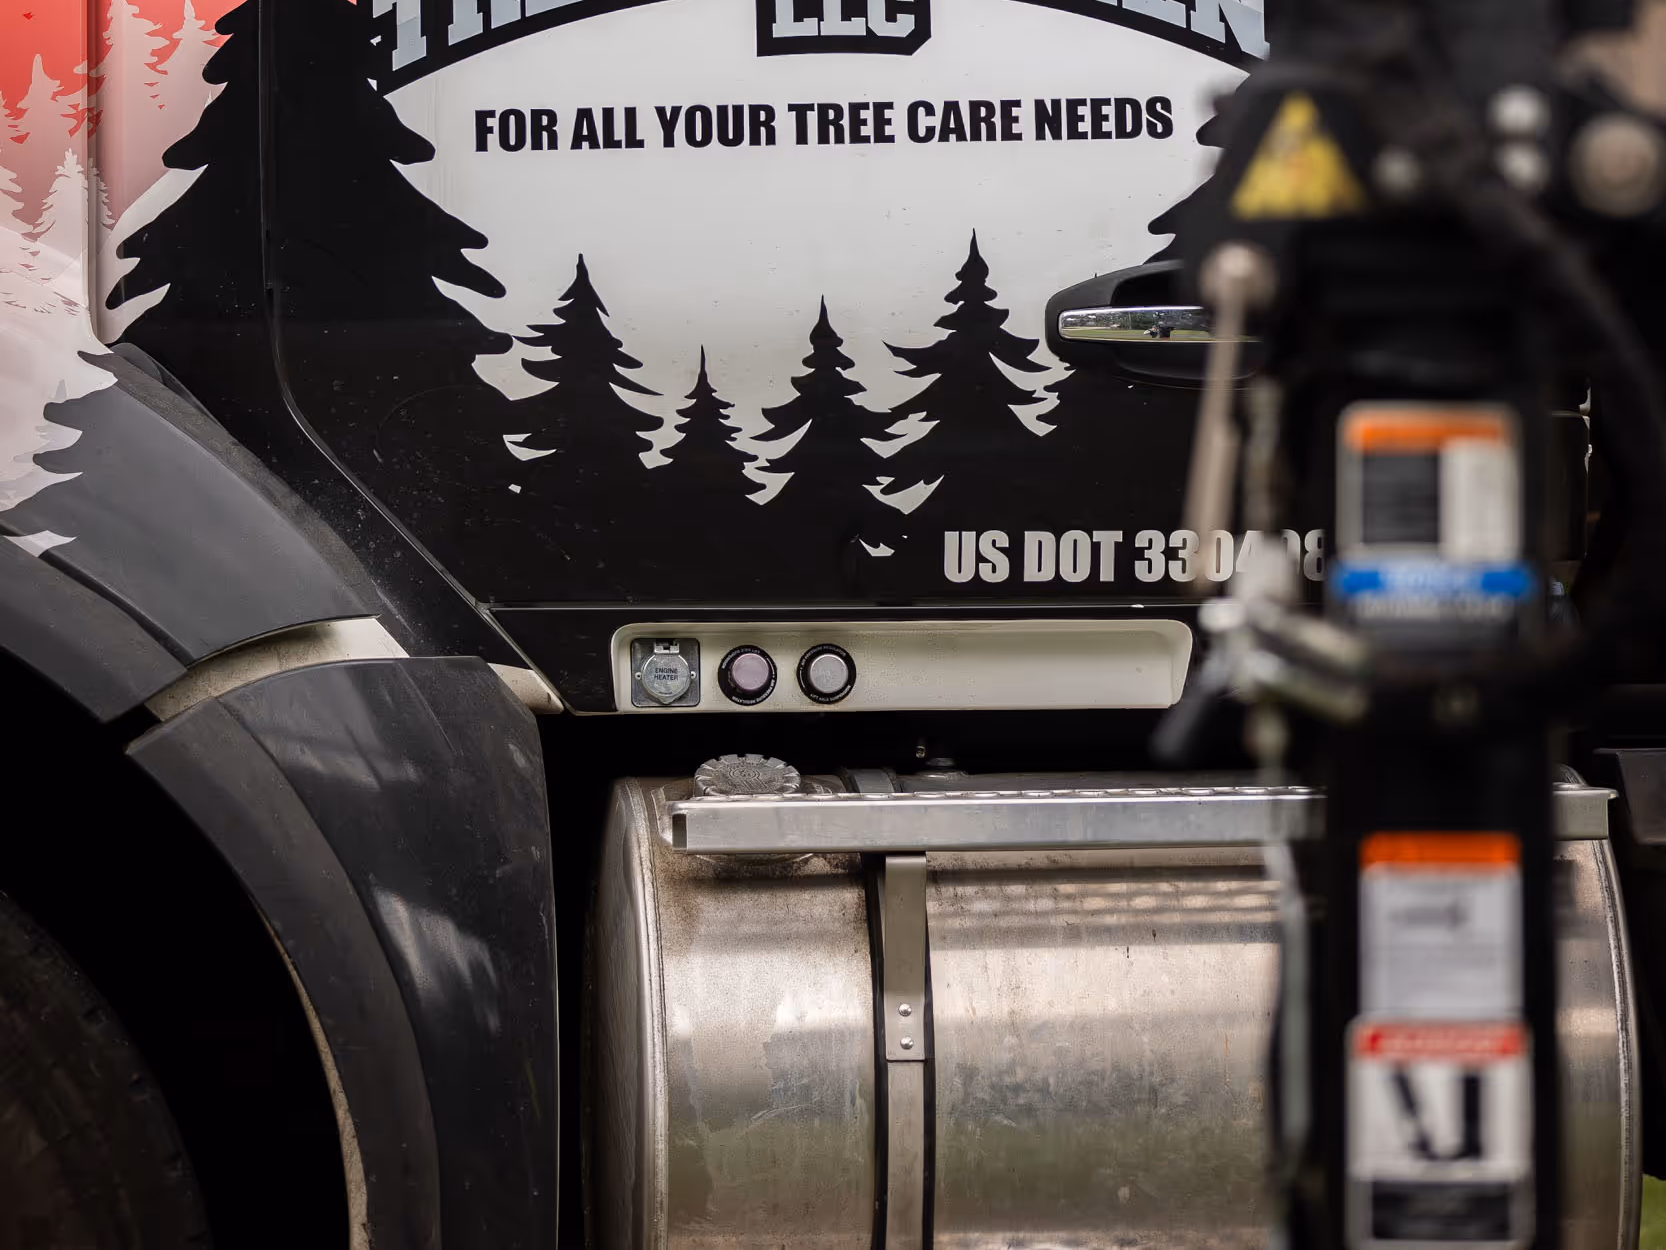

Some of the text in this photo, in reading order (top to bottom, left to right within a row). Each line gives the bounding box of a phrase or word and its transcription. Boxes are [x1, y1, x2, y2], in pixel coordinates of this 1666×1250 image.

[475, 95, 1174, 152] FOR ALL YOUR TREE CARE NEEDS
[944, 529, 1010, 582] US
[1023, 529, 1123, 582] DOT
